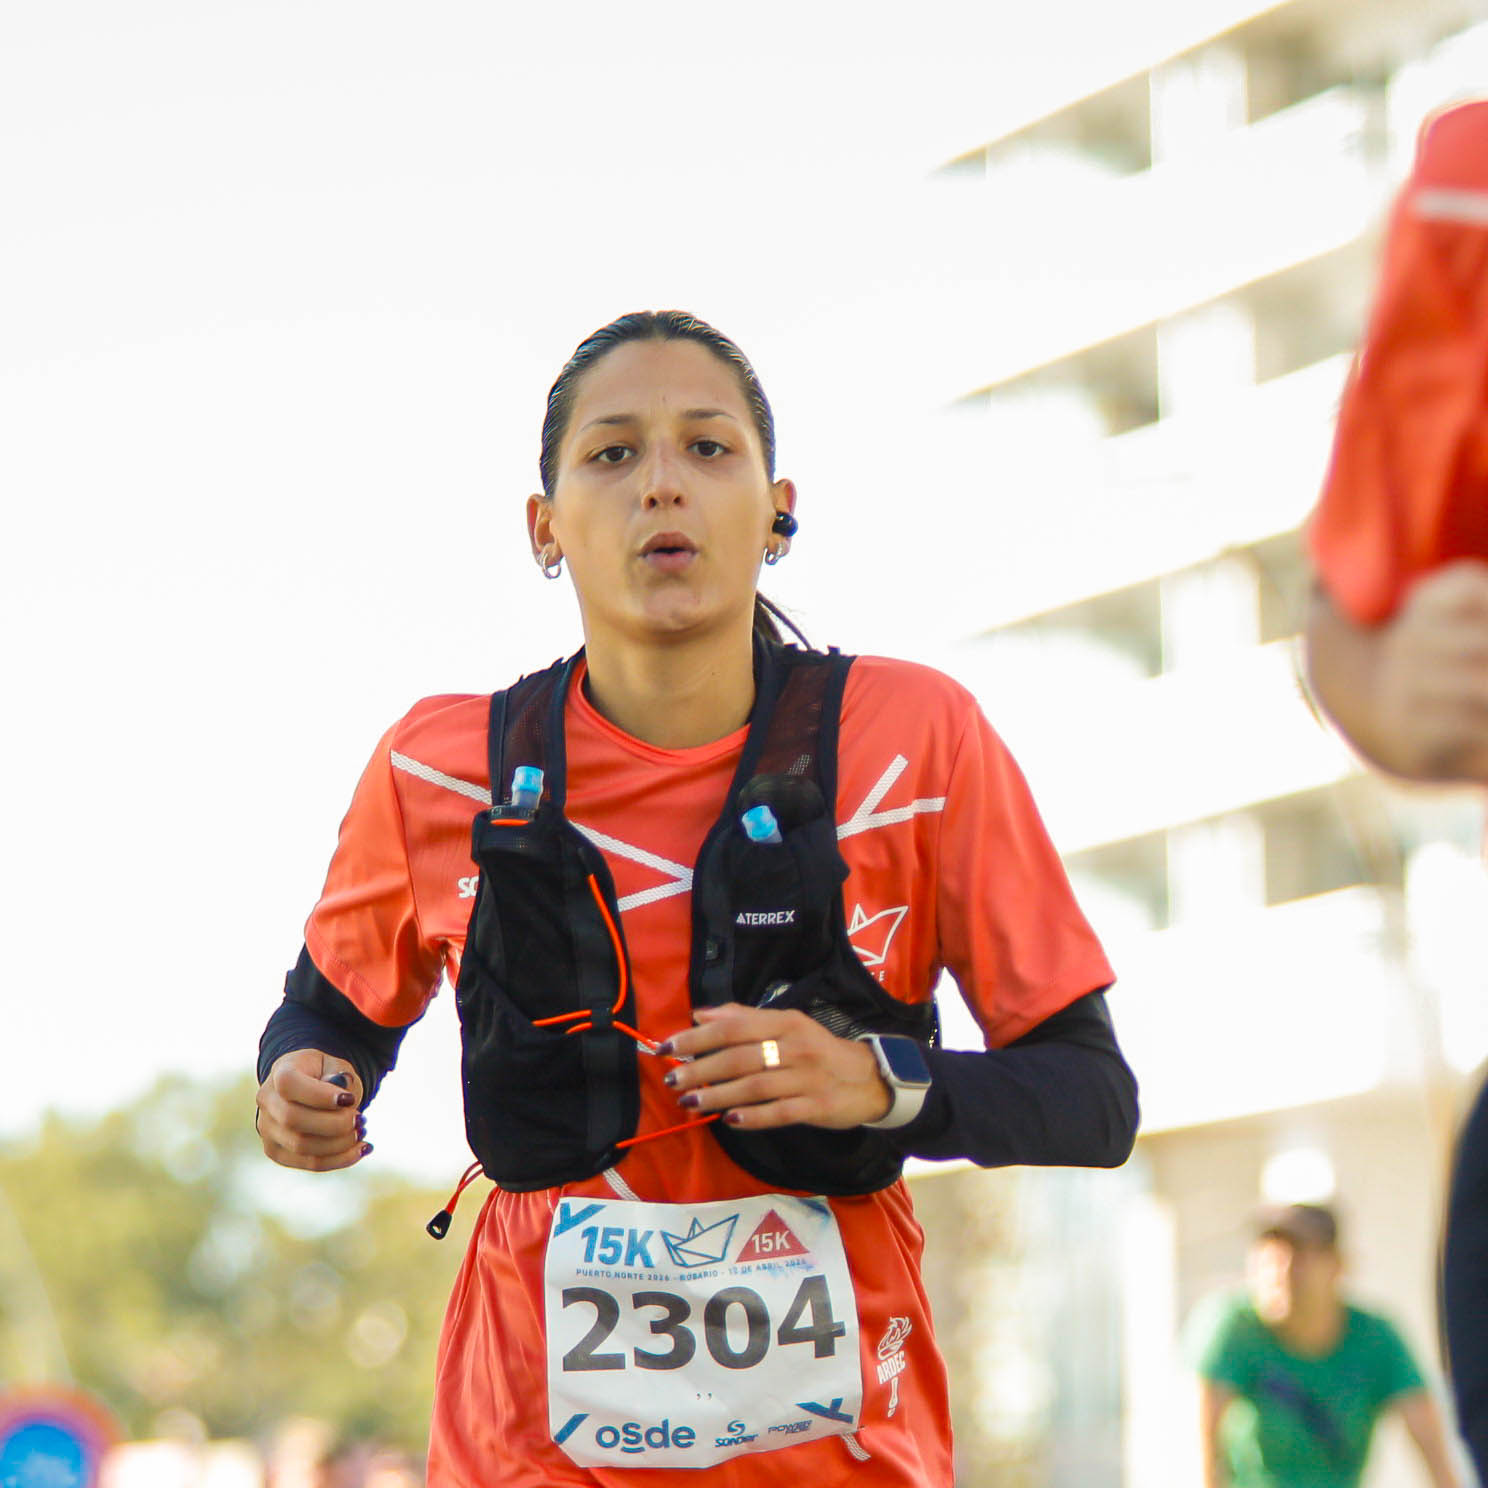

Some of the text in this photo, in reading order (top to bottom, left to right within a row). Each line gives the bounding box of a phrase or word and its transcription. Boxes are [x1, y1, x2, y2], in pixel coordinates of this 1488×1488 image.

[745, 910, 795, 925] TERREX
[581, 1226, 655, 1268] 15K
[751, 1230, 792, 1254] 15K
[576, 1268, 611, 1278] PUERTO
[614, 1271, 645, 1281] NORTE
[680, 1269, 719, 1281] ROSARIO
[562, 1274, 847, 1372] 2304
[876, 1350, 906, 1385] ARDEC
[595, 1418, 696, 1454] osde
